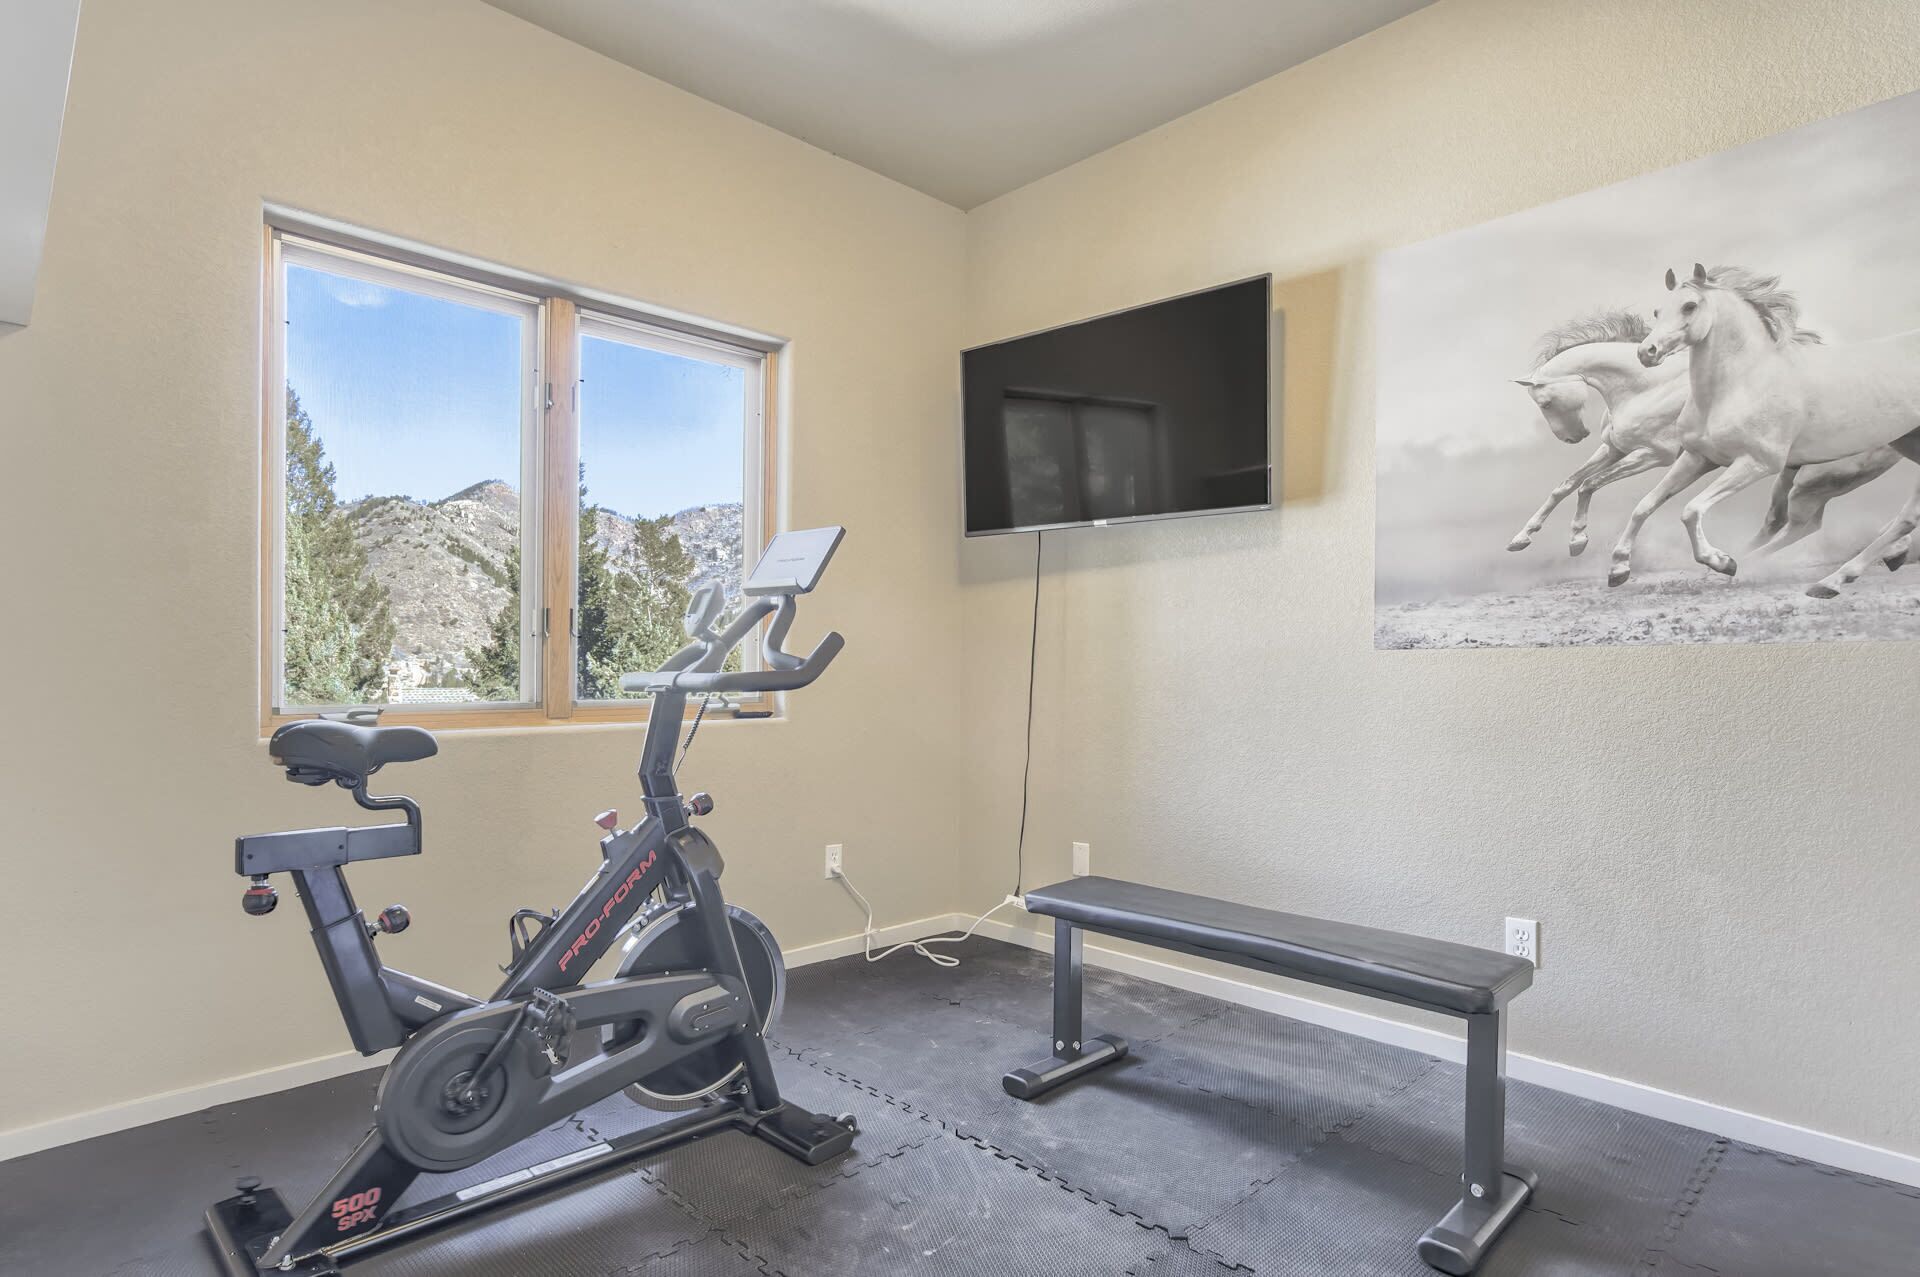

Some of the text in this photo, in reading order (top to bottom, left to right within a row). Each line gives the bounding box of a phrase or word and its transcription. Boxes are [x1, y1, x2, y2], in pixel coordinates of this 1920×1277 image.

[558, 849, 657, 972] PRO-FORM
[332, 1187, 382, 1218] 500
[337, 1205, 377, 1231] SPX
